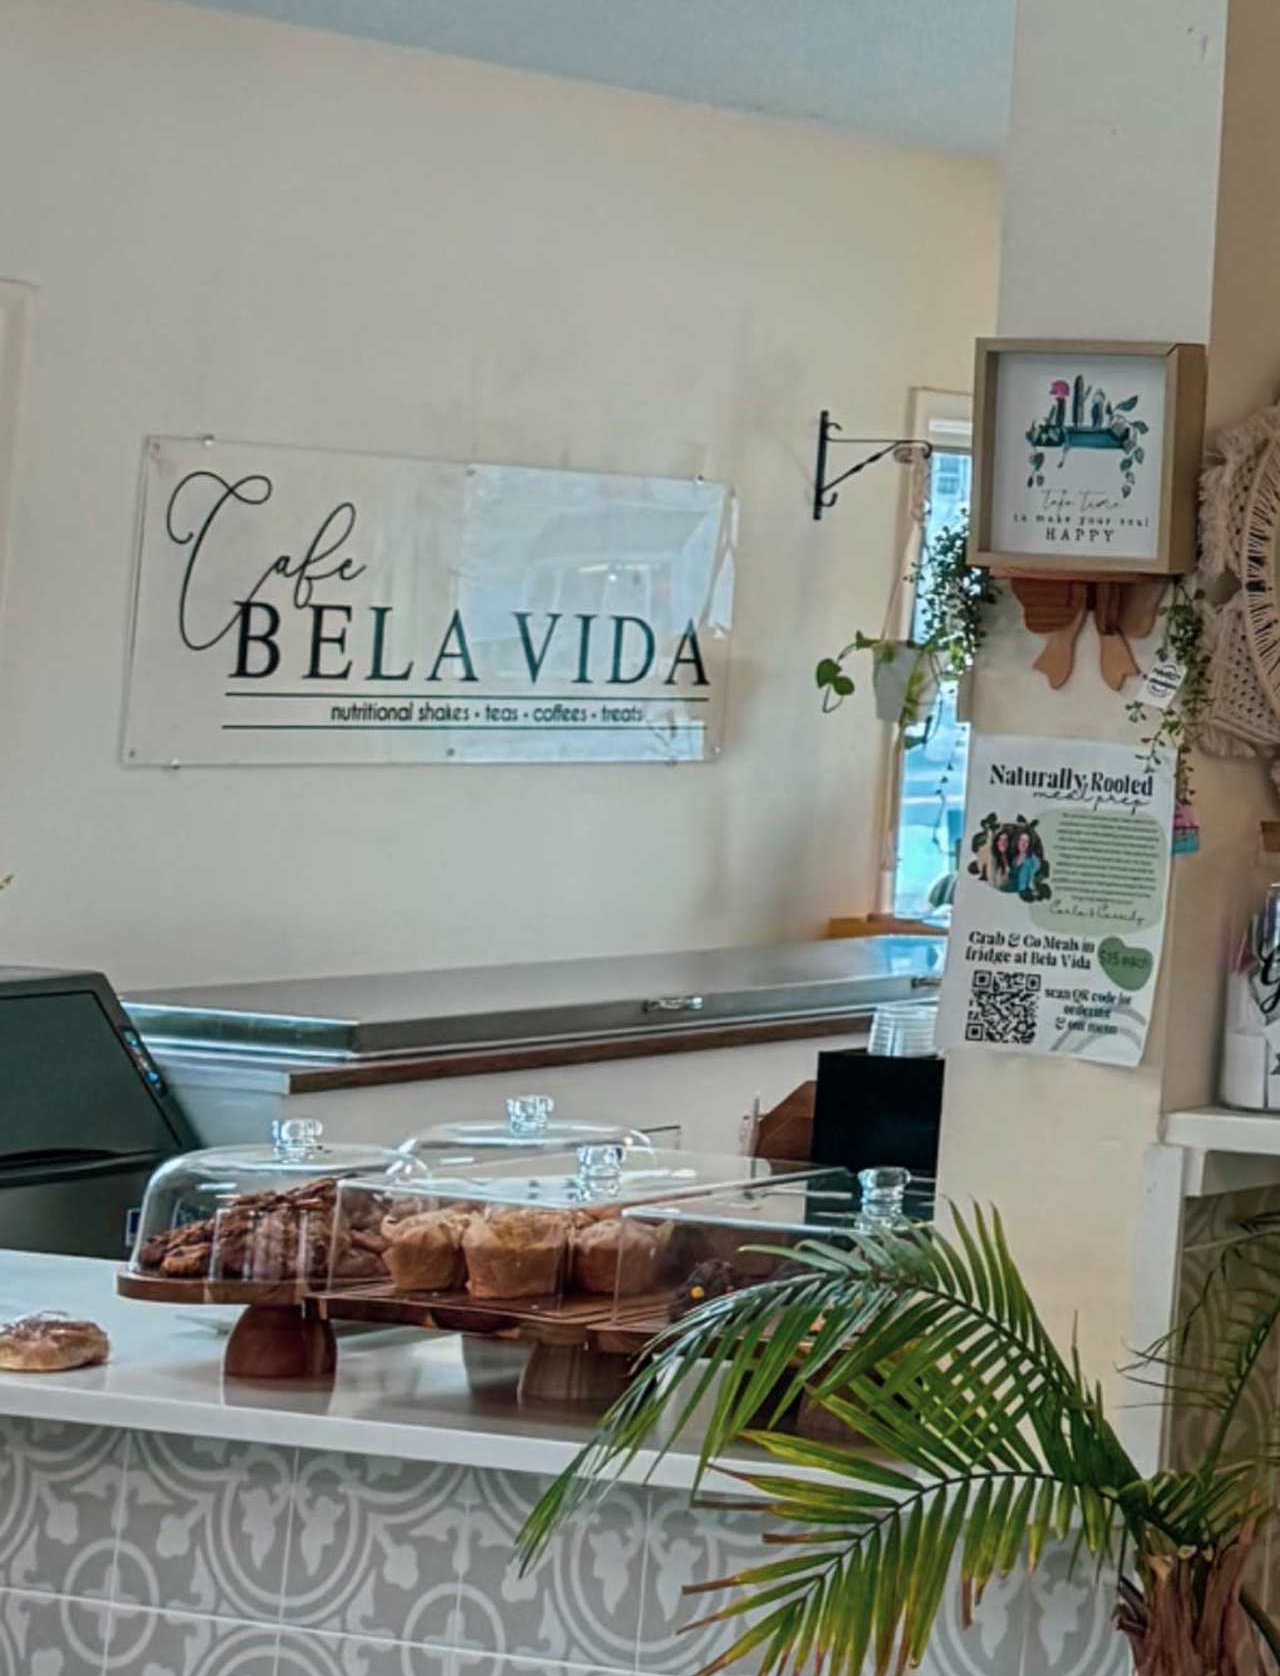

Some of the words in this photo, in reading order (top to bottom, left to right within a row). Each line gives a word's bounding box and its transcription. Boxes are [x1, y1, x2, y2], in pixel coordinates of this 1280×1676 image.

[1045, 526, 1115, 543] HAPPY
[166, 471, 367, 650] Cafe
[227, 599, 479, 682] BELA
[511, 610, 711, 687] VIDA
[330, 701, 415, 722] nutritional
[417, 702, 470, 722] shakes
[485, 704, 518, 723] teas
[533, 704, 588, 723] coffees
[600, 704, 644, 723] treats
[989, 763, 1089, 791] Naturally
[1090, 771, 1154, 797] Rooted
[1092, 794, 1151, 816] prep
[968, 930, 1006, 947] Grab
[1042, 934, 1080, 953] Meals
[965, 946, 1012, 966] fridge
[1030, 951, 1058, 968] Bela
[1060, 953, 1092, 971] Vida
